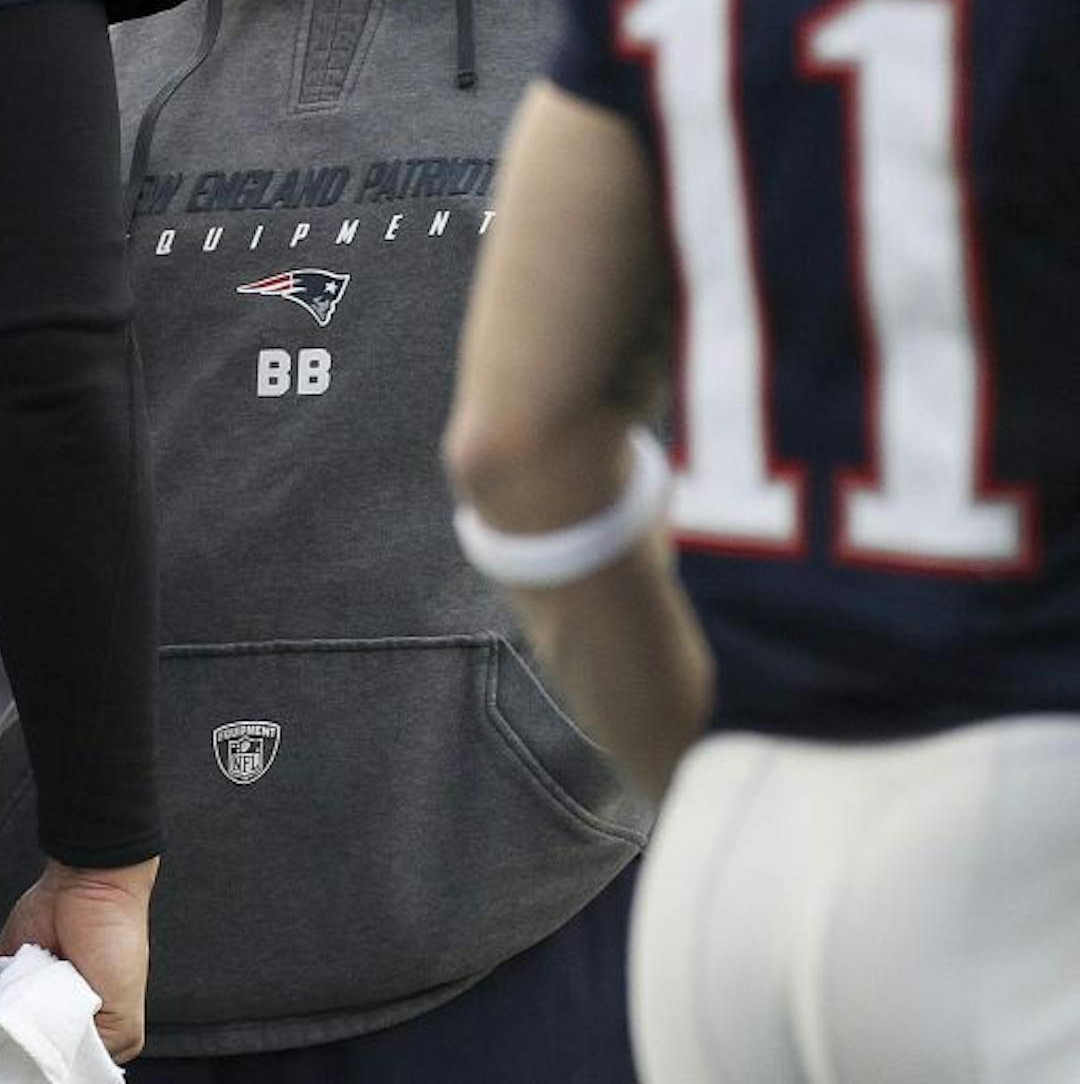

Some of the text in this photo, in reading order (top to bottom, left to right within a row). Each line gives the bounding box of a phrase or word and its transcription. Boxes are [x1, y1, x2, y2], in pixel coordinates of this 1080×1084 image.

[184, 166, 350, 214] ENGLAND
[355, 156, 498, 204] PATRIOT
[155, 210, 498, 257] QUIPMENT
[257, 347, 332, 398] BB
[229, 753, 261, 774] NFL
